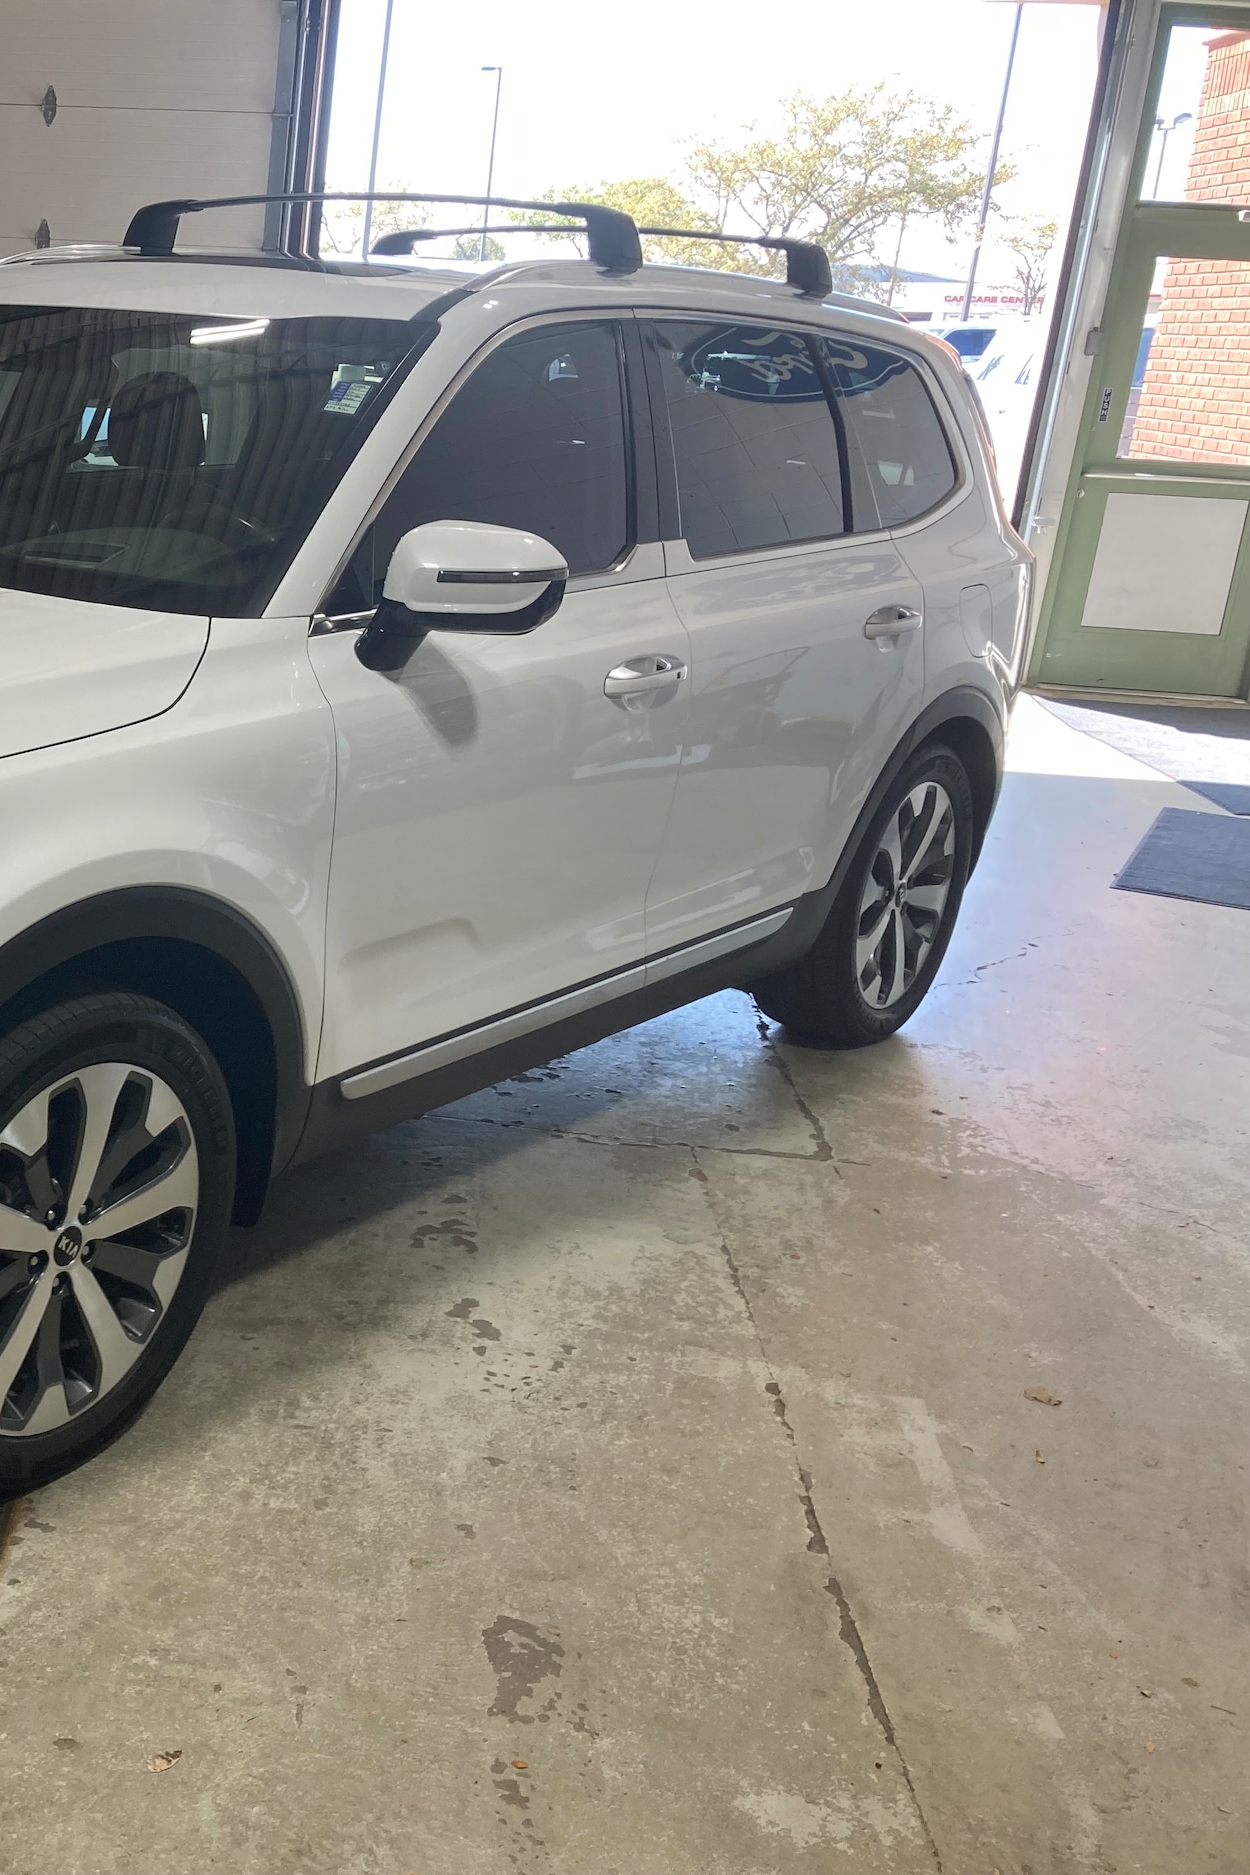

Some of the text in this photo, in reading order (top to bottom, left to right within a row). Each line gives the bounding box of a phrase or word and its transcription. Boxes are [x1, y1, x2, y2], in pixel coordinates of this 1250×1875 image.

[969, 296, 998, 304] CARE
[1000, 296, 1044, 304] CENER
[1101, 389, 1111, 416] PUSH
[58, 1235, 79, 1258] KIA
